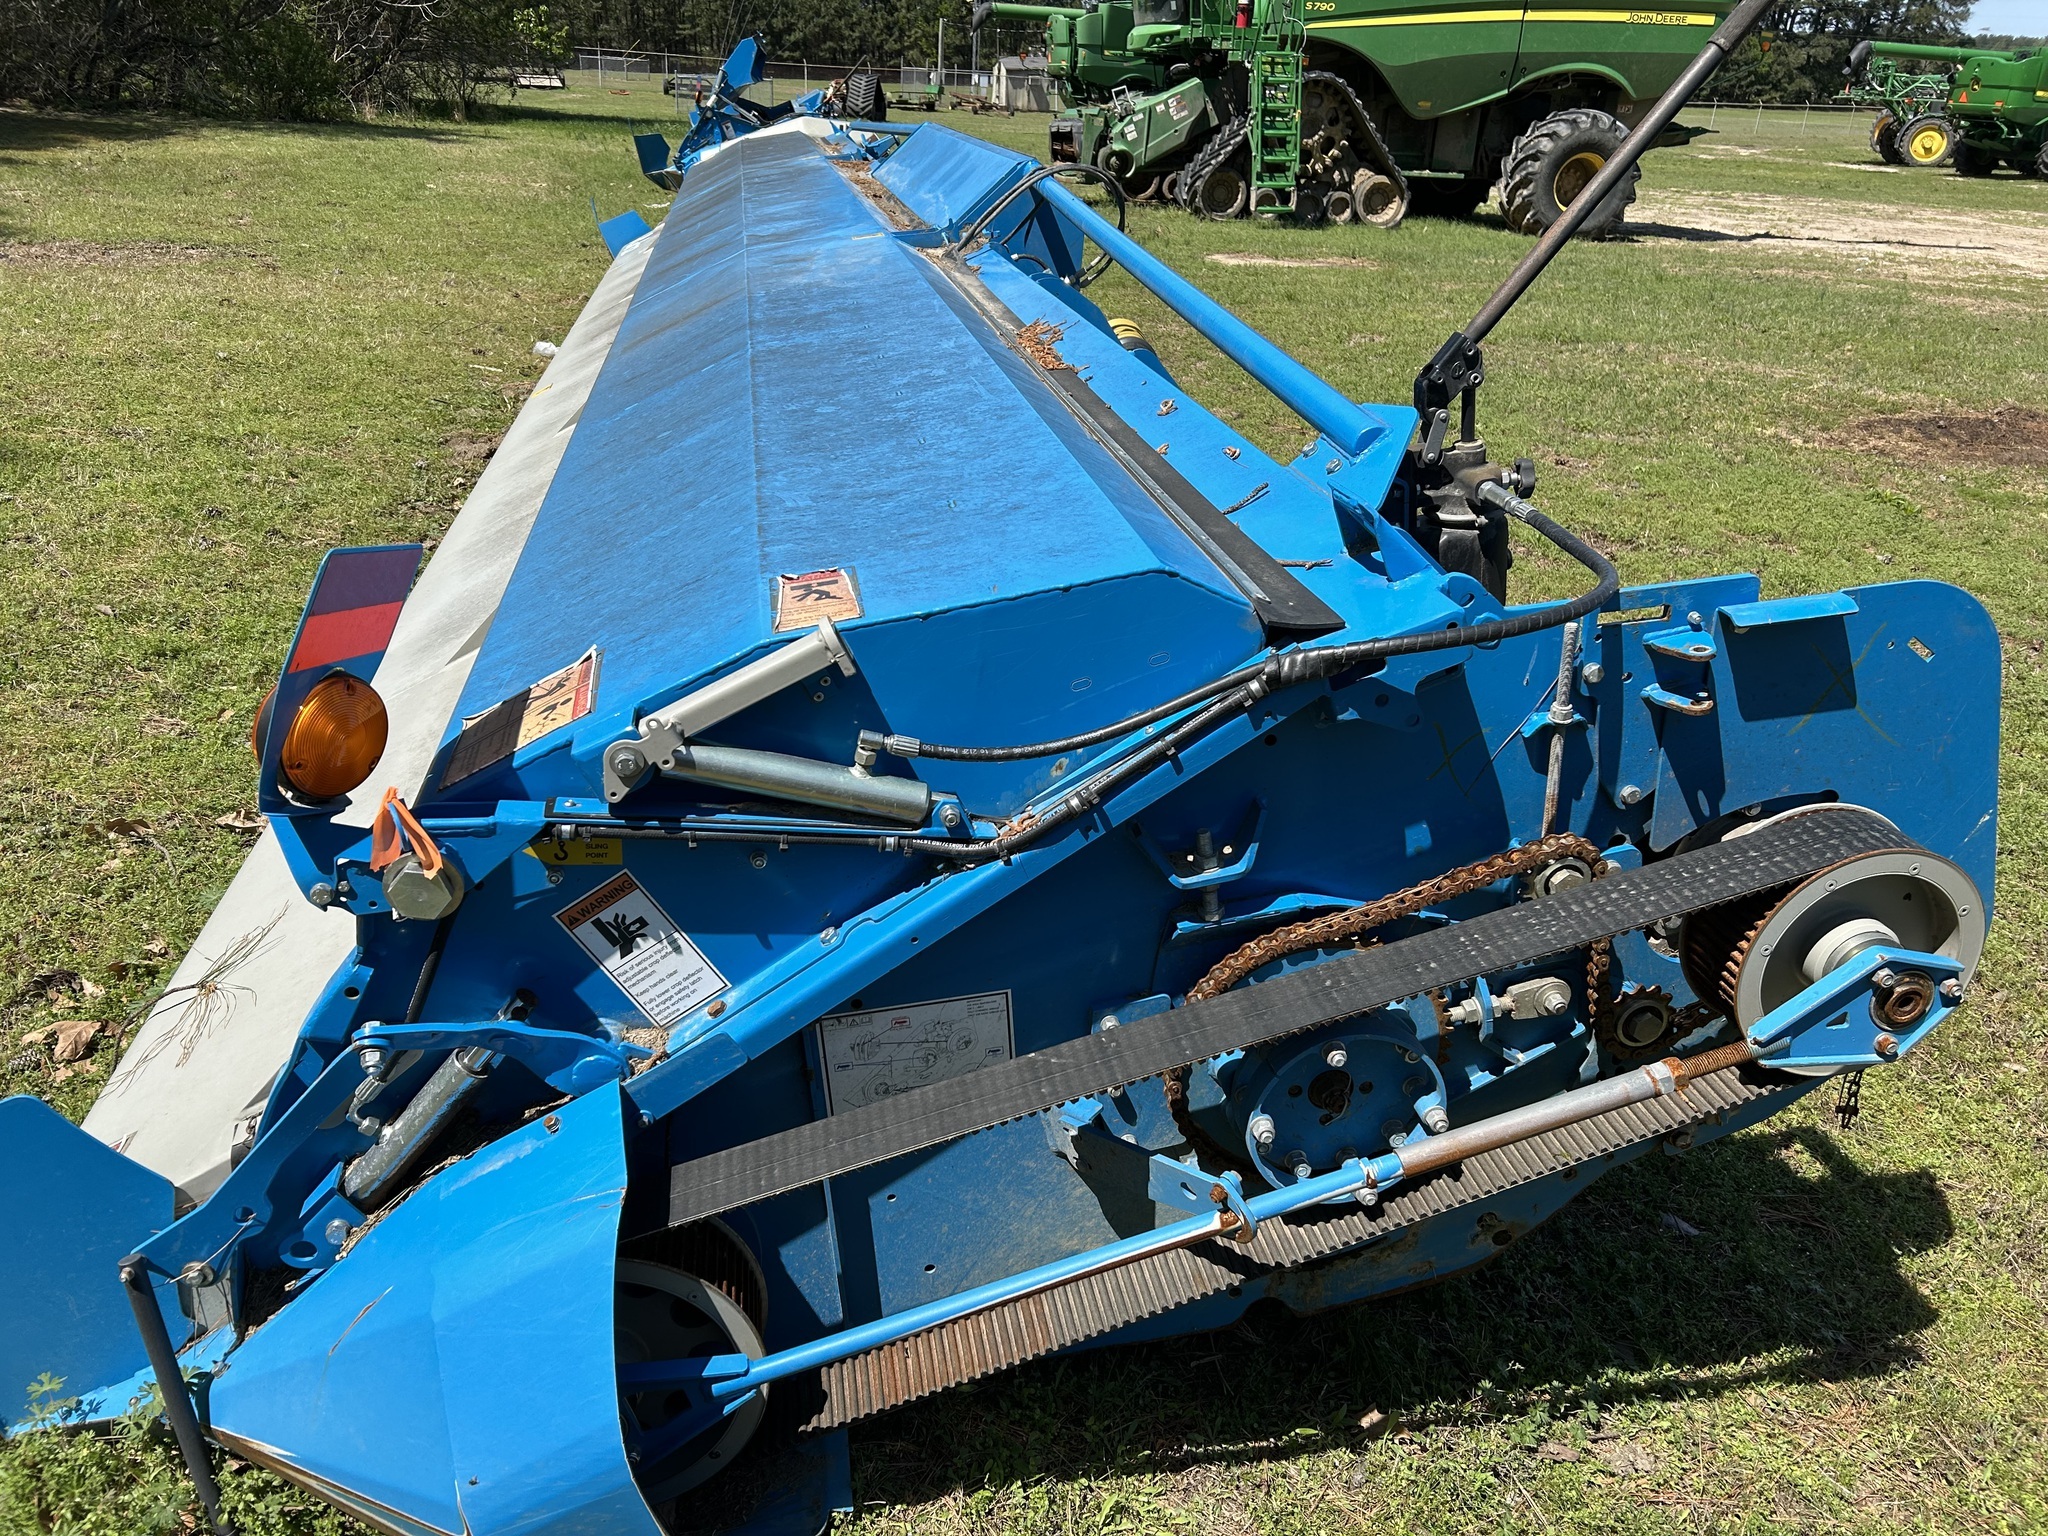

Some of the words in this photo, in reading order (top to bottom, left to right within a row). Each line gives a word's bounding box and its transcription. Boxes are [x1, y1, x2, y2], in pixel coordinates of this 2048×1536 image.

[1305, 1, 1336, 11] S790
[1626, 12, 1654, 22] JOHN
[1655, 12, 1688, 24] DEERE
[922, 744, 934, 752] ISO
[576, 879, 634, 919] WARNING
[616, 968, 630, 979] Risk
[629, 963, 635, 971] of
[635, 953, 655, 968] serious
[654, 944, 668, 957] injury
[622, 965, 648, 984] adjustable
[648, 958, 661, 970] crop
[627, 969, 657, 990] mechanism
[635, 985, 650, 998] Keep
[649, 976, 666, 989] hands
[665, 968, 679, 980] clear
[643, 996, 657, 1007] Fully
[656, 988, 671, 999] lower
[670, 980, 683, 992] crop
[682, 965, 704, 983] deflector
[655, 994, 675, 1009] engage
[674, 984, 690, 998] safety
[690, 975, 704, 987] latch
[653, 1005, 671, 1018] before
[670, 992, 691, 1008] working
[690, 987, 698, 996] on
[659, 1006, 681, 1023] machine
